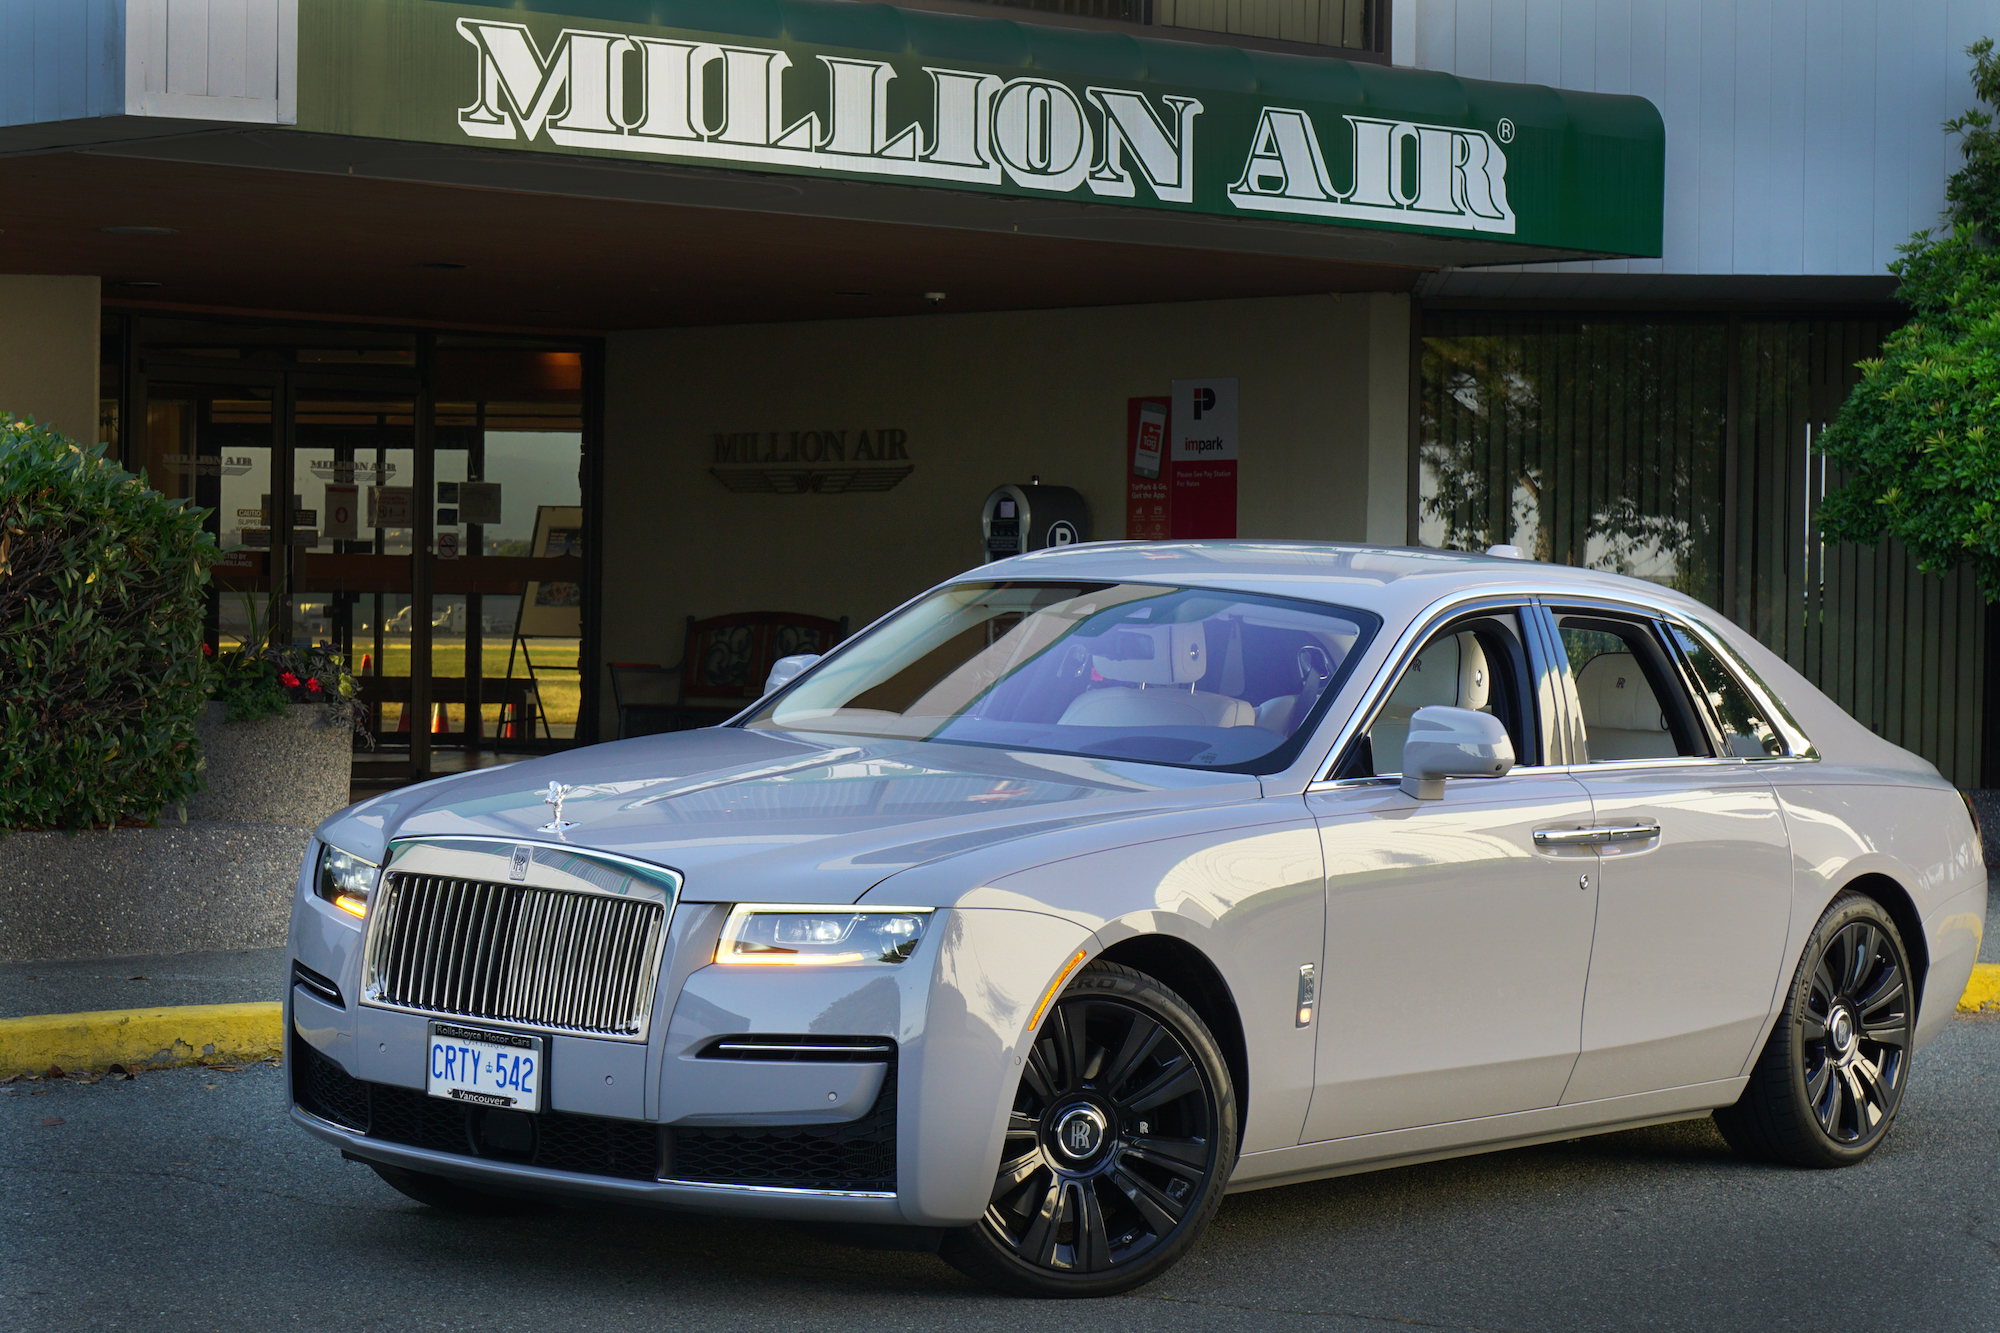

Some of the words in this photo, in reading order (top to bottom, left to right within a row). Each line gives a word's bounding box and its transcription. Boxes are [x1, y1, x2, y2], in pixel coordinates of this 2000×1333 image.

[456, 17, 1204, 204] MILLION
[713, 430, 847, 463] MILLION
[852, 429, 909, 461] AIR
[1143, 435, 1157, 451] Tag
[1185, 436, 1223, 454] impark
[225, 456, 252, 467] AIR
[310, 460, 369, 471] MILLION
[370, 462, 397, 472] AIR
[1203, 470, 1213, 478] Pay
[1131, 491, 1142, 499] Get
[1143, 491, 1152, 499] the
[1055, 527, 1072, 547] P
[437, 1025, 482, 1040] Rolls-Royce
[484, 1032, 509, 1044] Motor
[511, 1037, 530, 1047] Cars
[432, 1044, 481, 1085] CRTY
[496, 1053, 534, 1093] 542
[459, 1090, 505, 1105] Vancouver
[1070, 1120, 1091, 1149] RR
